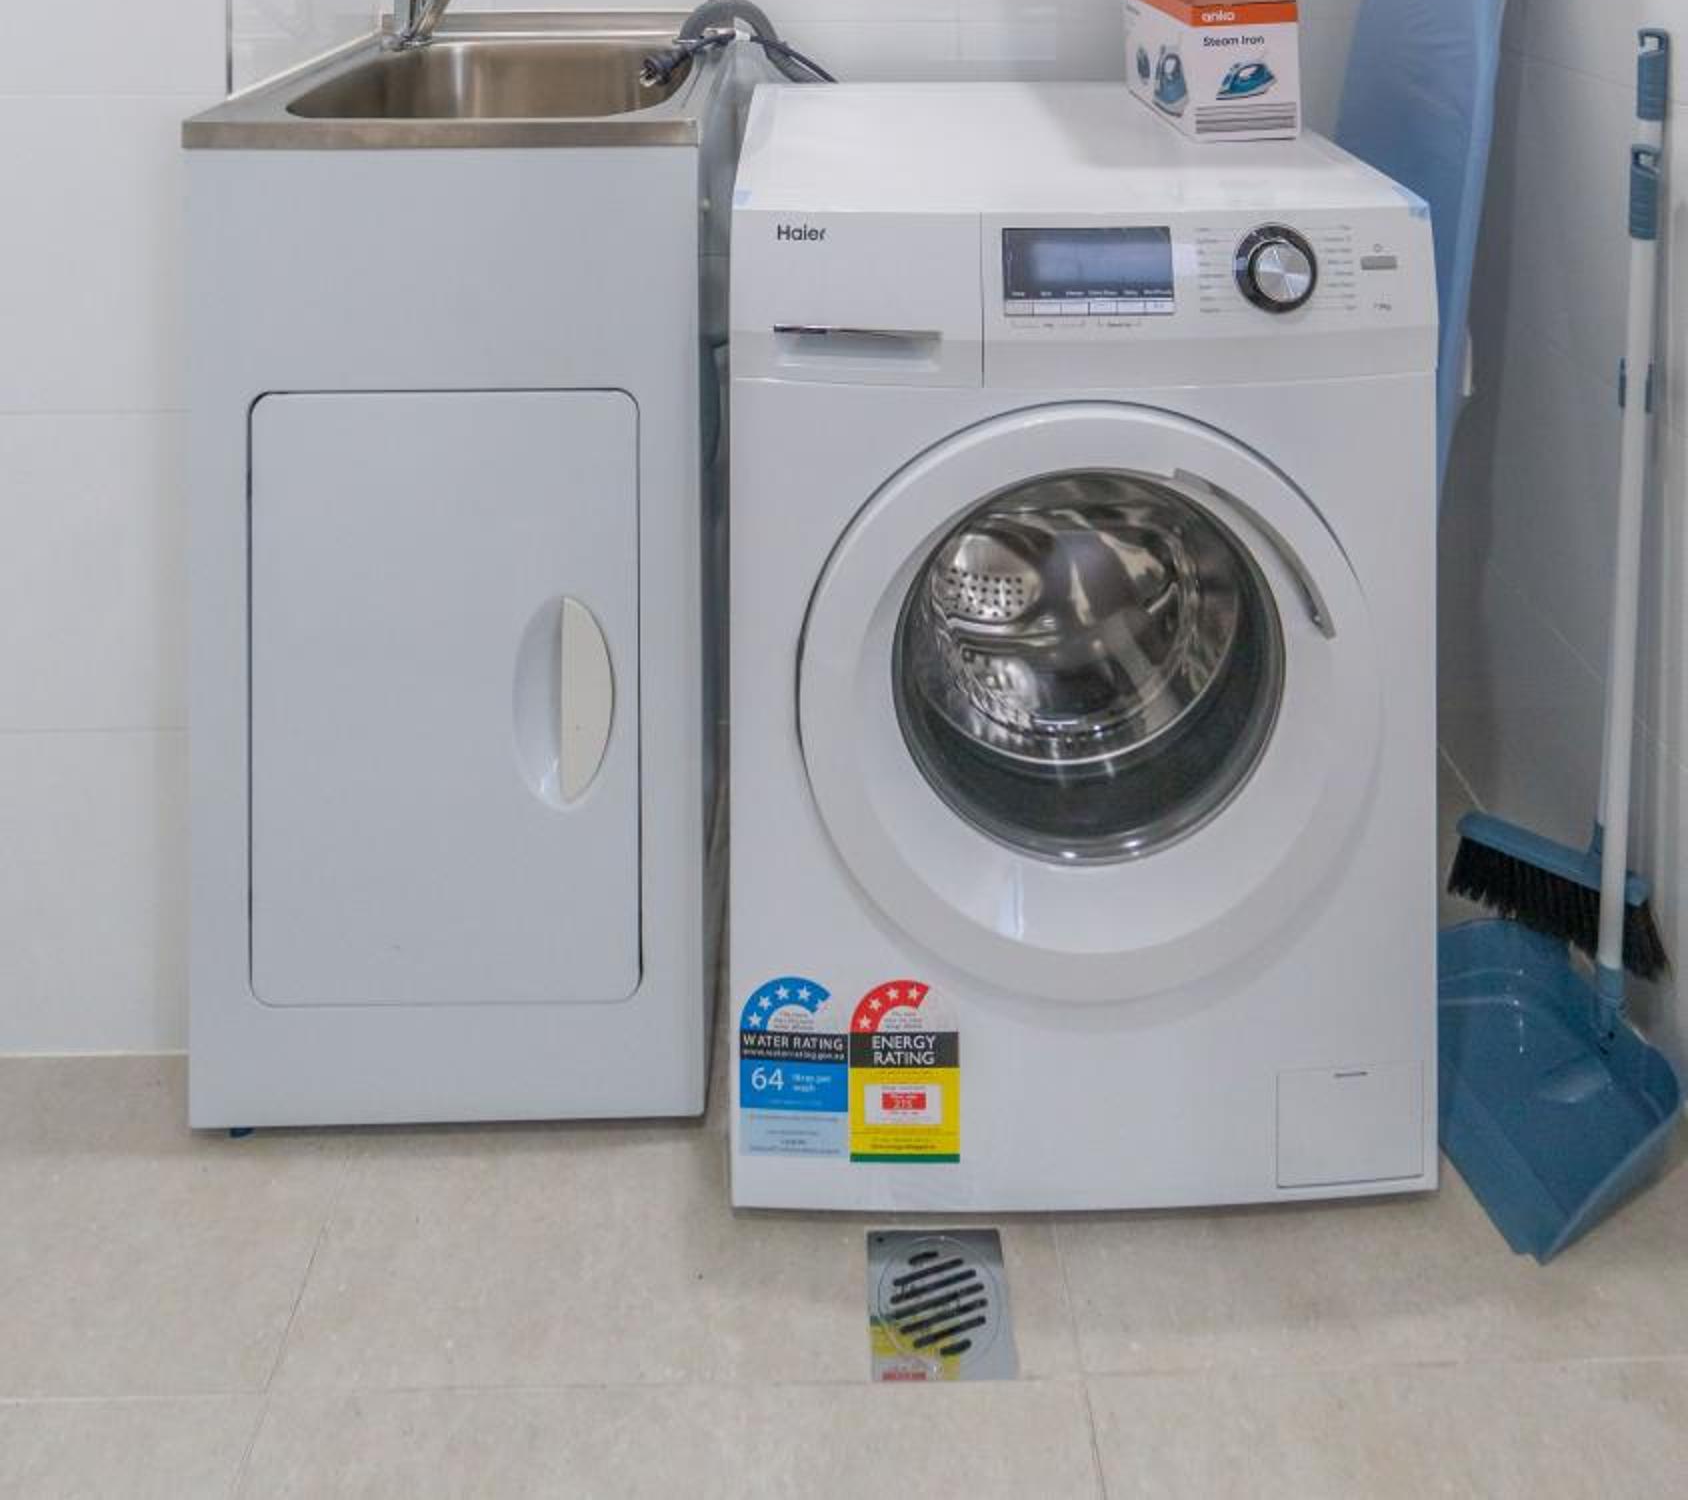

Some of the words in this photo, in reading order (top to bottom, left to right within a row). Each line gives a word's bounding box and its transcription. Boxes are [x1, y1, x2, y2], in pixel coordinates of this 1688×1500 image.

[1201, 10, 1235, 22] anko
[1203, 35, 1239, 47] Steam
[1242, 35, 1265, 46] Iron
[777, 224, 826, 241] Haier
[743, 1033, 789, 1048] WATER
[793, 1035, 844, 1052] RATING
[872, 1035, 937, 1050] ENERGY
[873, 1051, 935, 1066] RATING
[751, 1066, 784, 1091] 64
